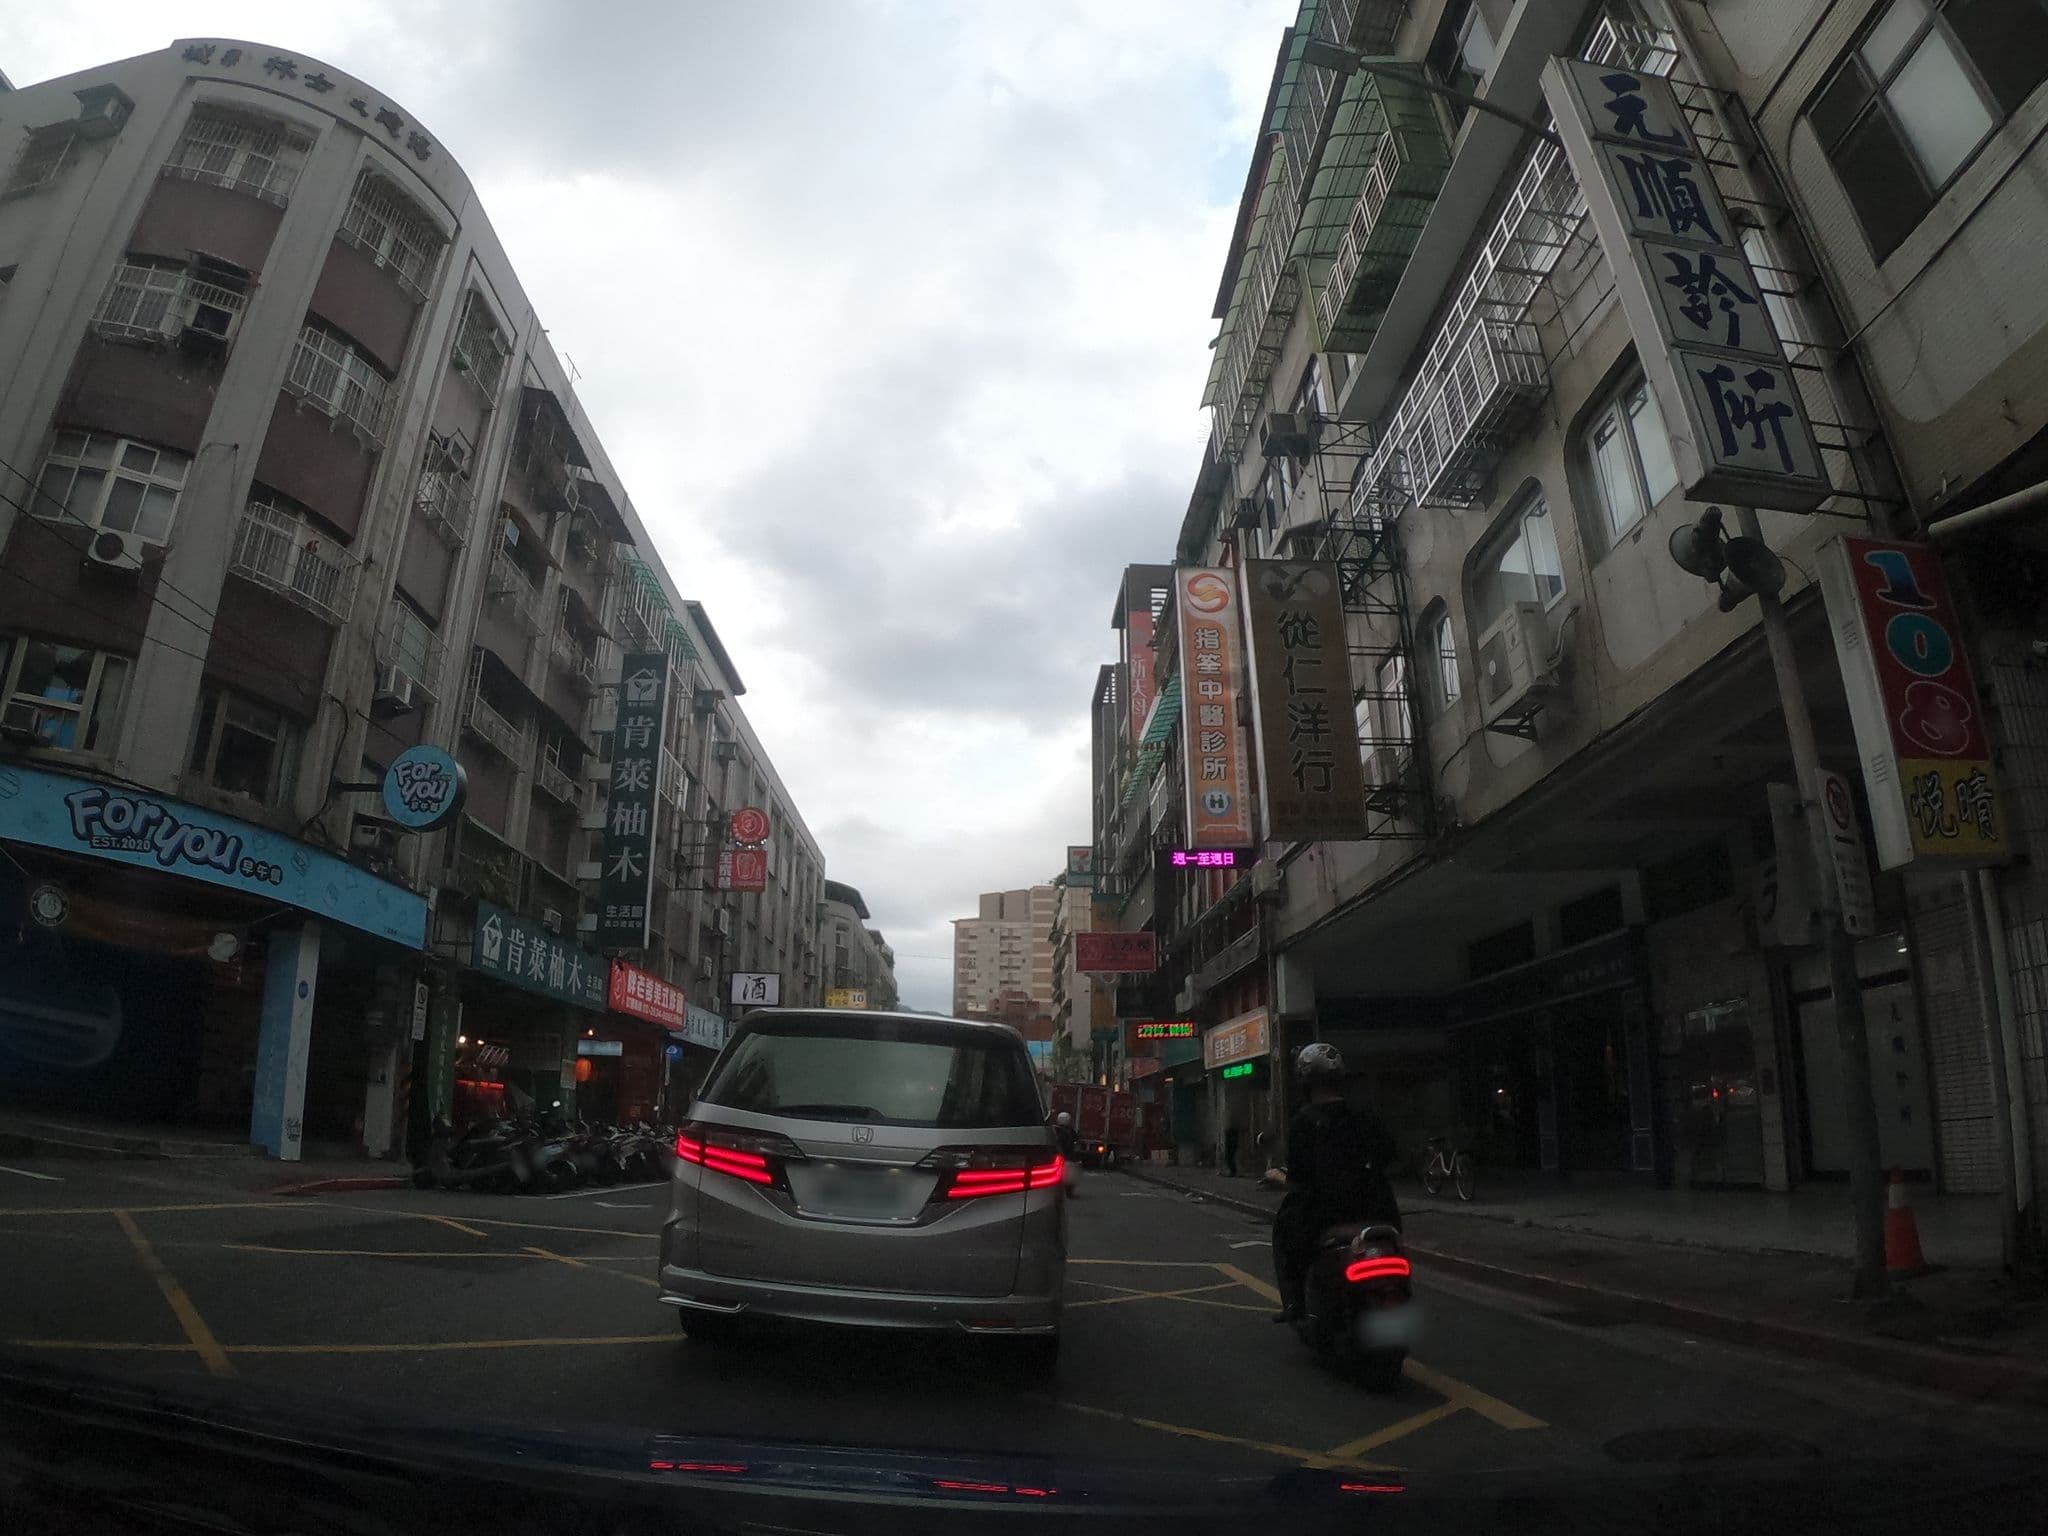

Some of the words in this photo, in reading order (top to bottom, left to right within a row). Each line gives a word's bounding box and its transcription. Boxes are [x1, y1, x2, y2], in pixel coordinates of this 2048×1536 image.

[1599, 73, 1794, 473] 元順診所
[1195, 629, 1227, 780] 指筌中醫診所
[1277, 609, 1335, 793] 從仁洋行
[1863, 550, 1973, 755] 108
[607, 715, 655, 883] 肯萊柚木
[1173, 852, 1234, 865] 週一至週日
[506, 928, 583, 995] 肯萊柚木
[743, 976, 766, 1001] 酒
